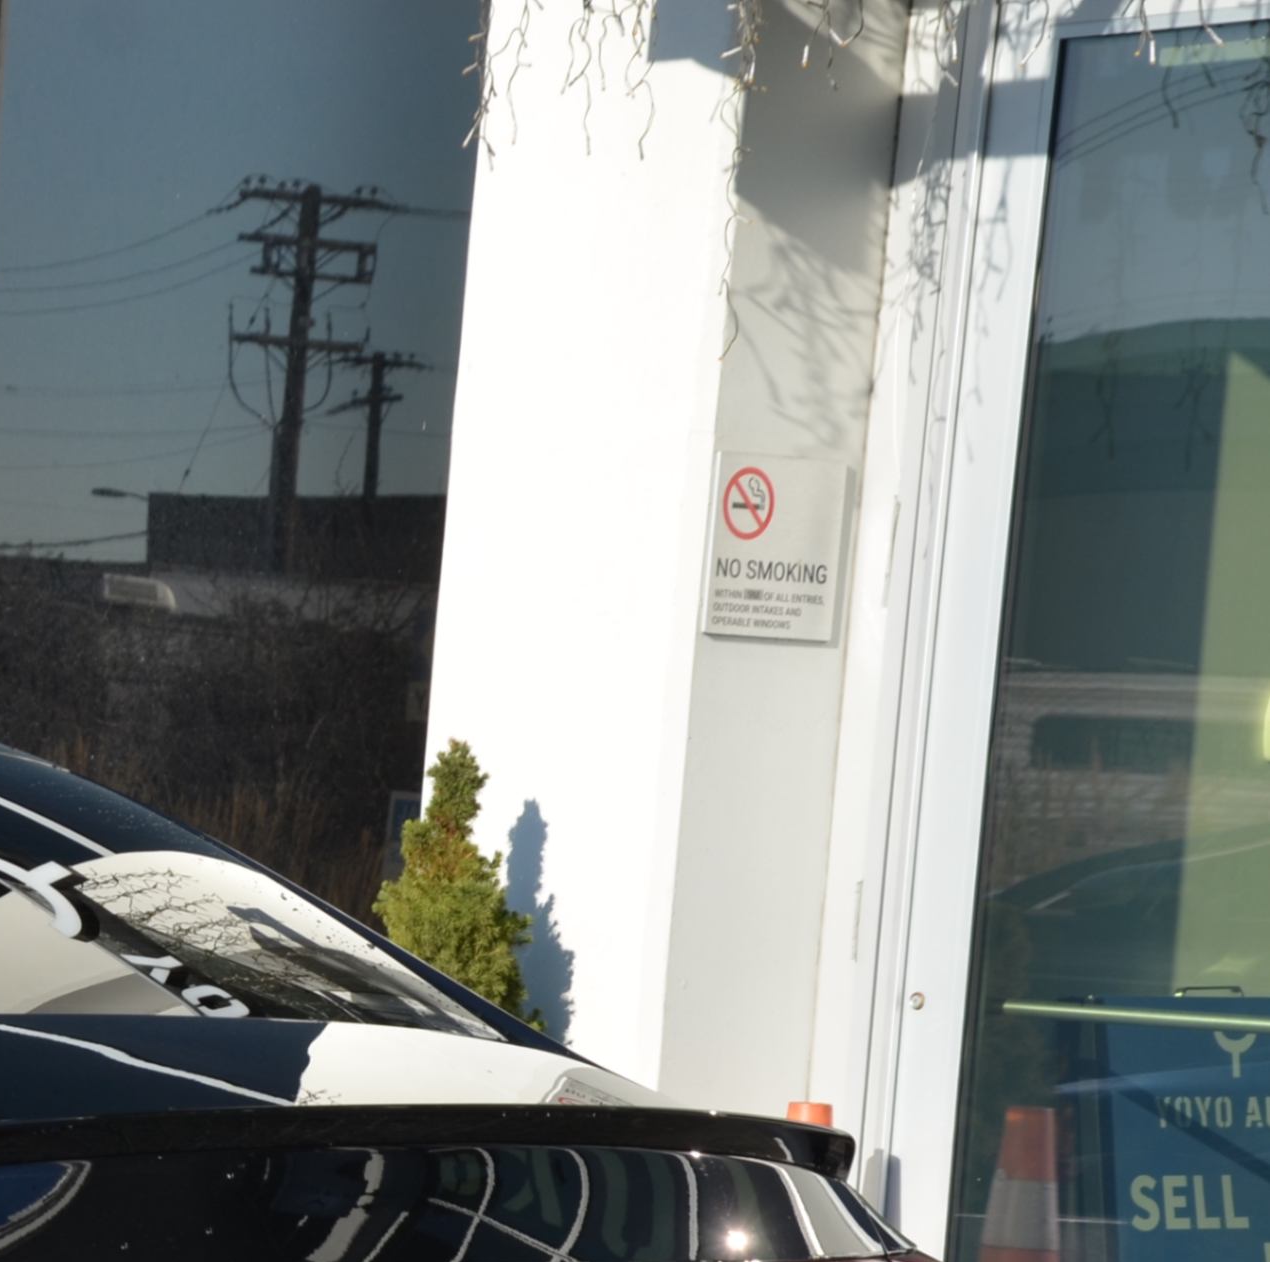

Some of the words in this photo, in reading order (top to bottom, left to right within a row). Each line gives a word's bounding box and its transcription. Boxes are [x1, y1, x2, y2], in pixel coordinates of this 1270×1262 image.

[716, 557, 741, 578] NO
[745, 559, 828, 584] SMOKING
[714, 588, 742, 599] WITHIN
[763, 591, 775, 600] OF
[776, 592, 790, 602] ALL
[712, 602, 750, 613] OUTDOOR
[752, 604, 784, 615] INTAKES
[786, 606, 802, 617] AND
[711, 615, 751, 627] OPERABLE
[753, 619, 791, 629] WINDOWS
[1156, 1095, 1234, 1128] YOYO
[1129, 1174, 1250, 1232] SELL
